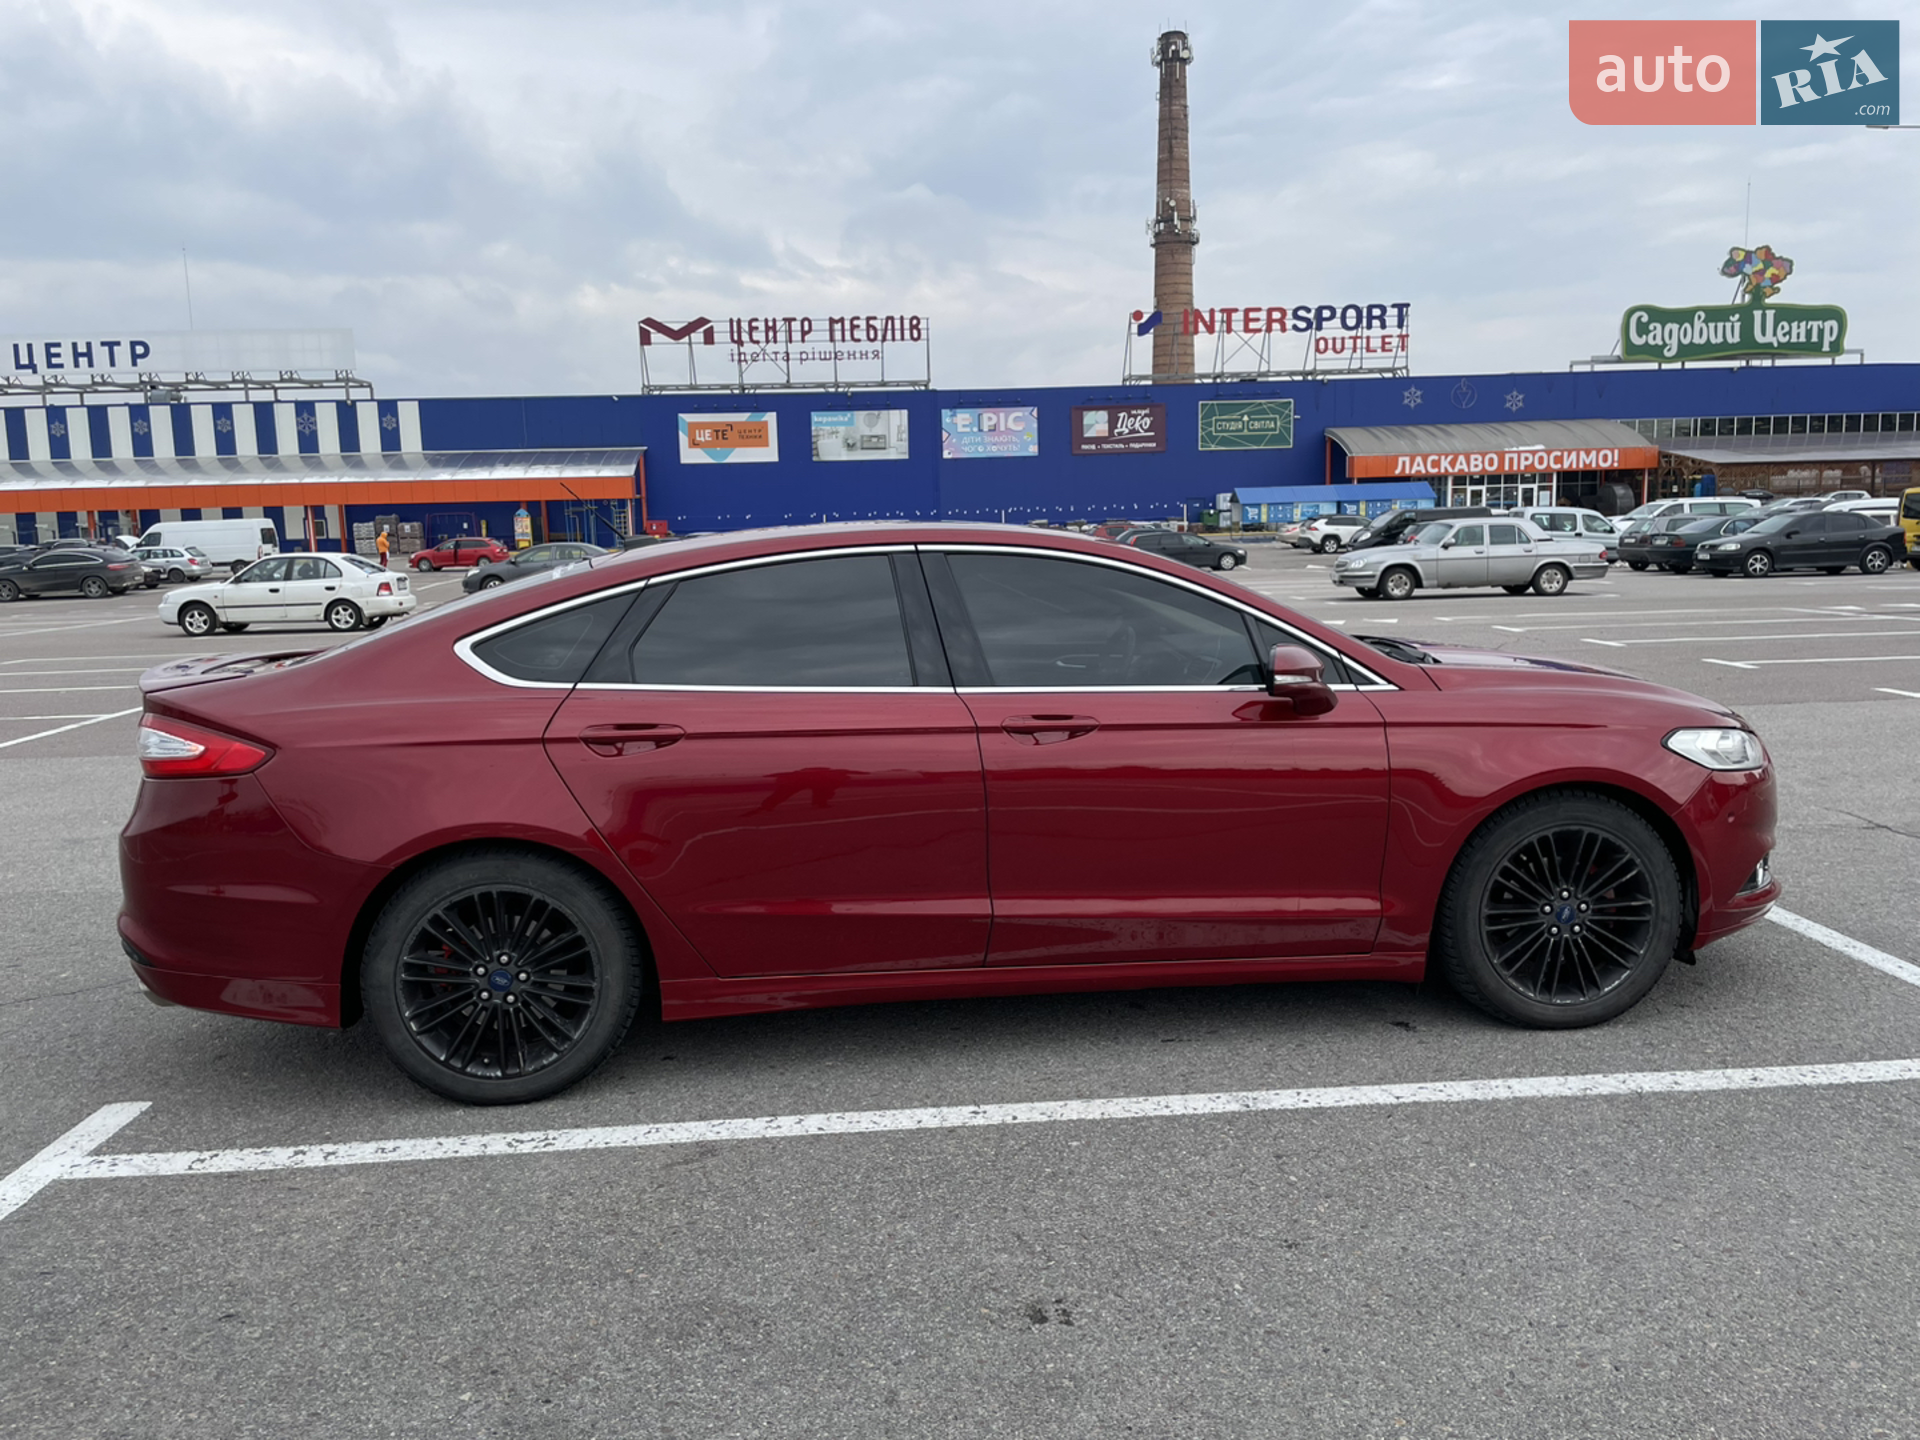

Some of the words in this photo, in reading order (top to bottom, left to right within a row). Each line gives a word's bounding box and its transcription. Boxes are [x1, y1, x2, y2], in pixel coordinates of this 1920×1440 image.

[729, 317, 813, 347] ЦЕНТР
[828, 315, 922, 343] МЕБЛІВ
[1182, 303, 1411, 336] INTERSPORT
[1629, 310, 1741, 358] Садовий
[1752, 309, 1839, 352] Центр
[12, 340, 151, 374] ЦЕНТР
[772, 351, 790, 362] та
[800, 347, 880, 365] рішення
[1315, 334, 1410, 355] OUTLET
[1216, 421, 1243, 431] СТУДІЯ
[1249, 420, 1276, 430] СВІТЛА
[1394, 453, 1499, 475] ЛАСКАВО
[1504, 449, 1620, 472] ПРОСИМО!
